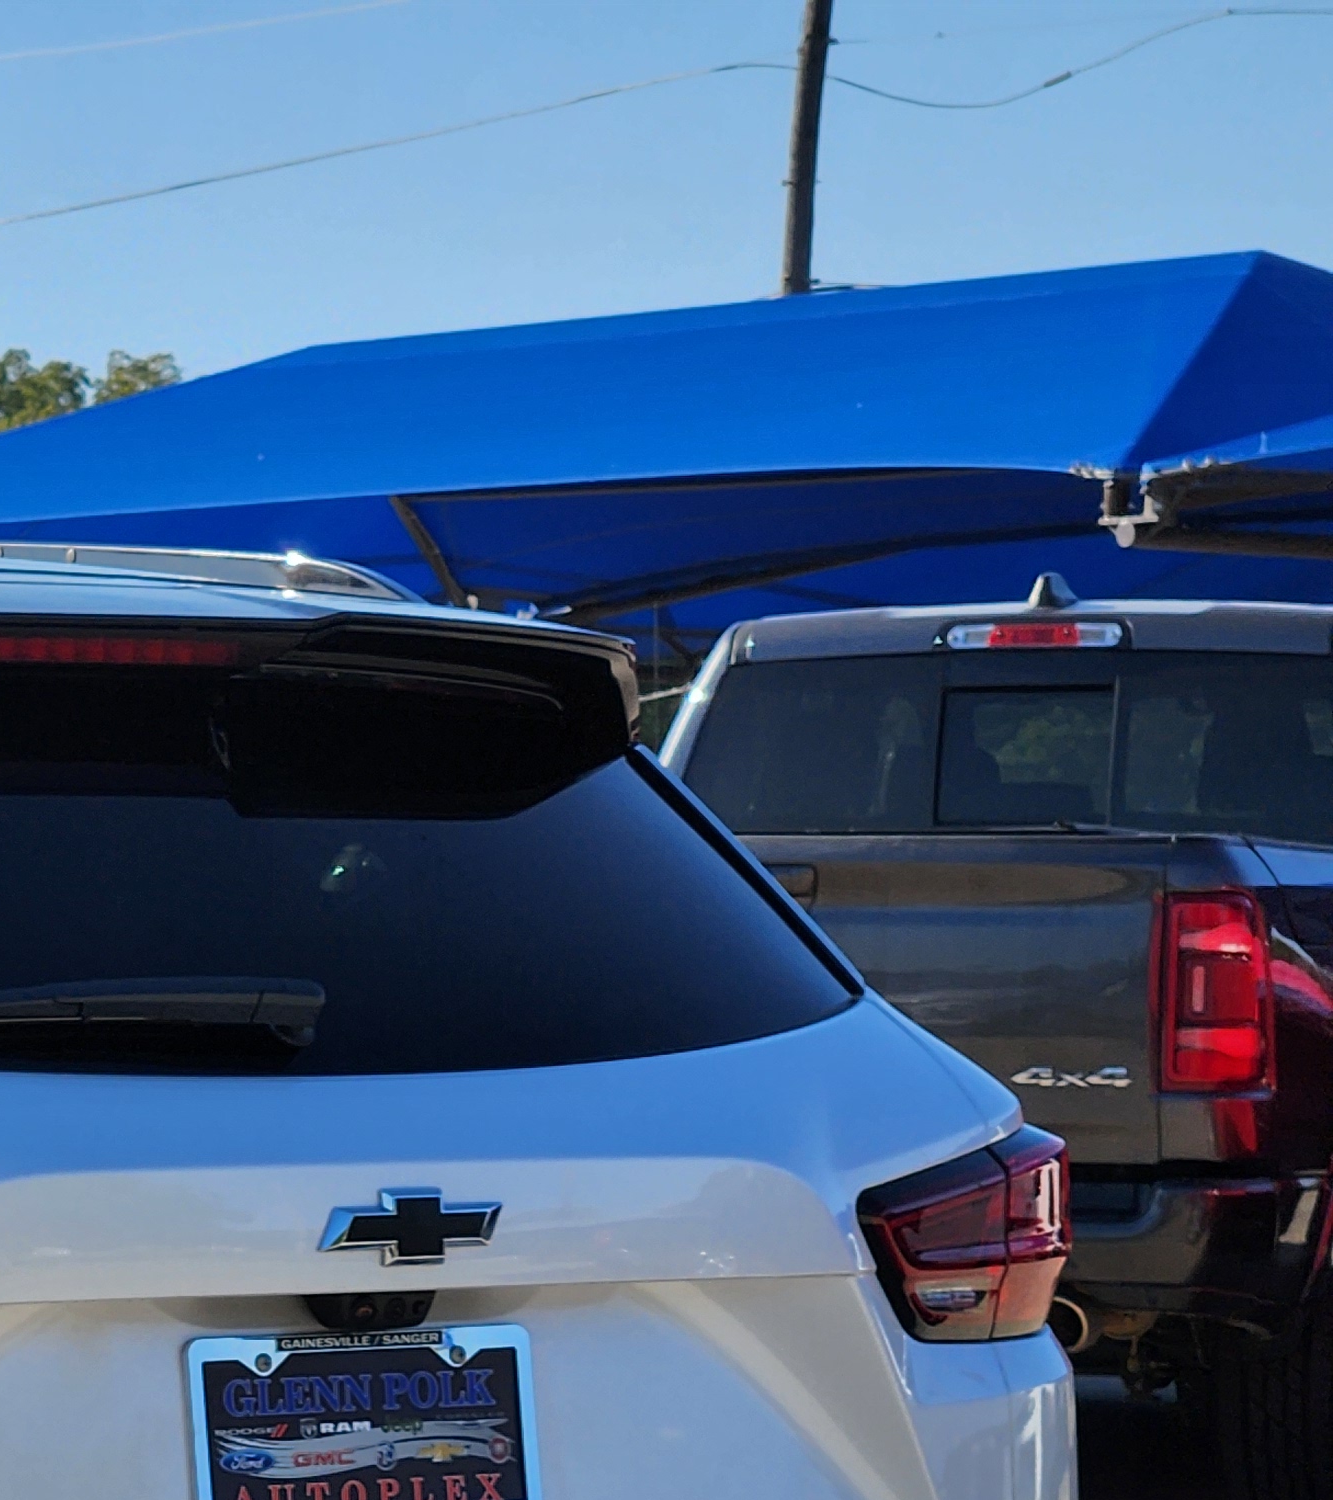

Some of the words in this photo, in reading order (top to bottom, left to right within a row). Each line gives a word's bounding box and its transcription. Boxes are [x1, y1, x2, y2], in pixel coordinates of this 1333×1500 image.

[1010, 1066, 1133, 1088] 4x4
[281, 1334, 371, 1349] GAINESVILLE
[382, 1332, 439, 1345] SANGER
[223, 1373, 372, 1418] GLENN
[381, 1368, 497, 1411] POLK
[319, 1420, 372, 1434] RAM
[292, 1449, 356, 1467] GMC
